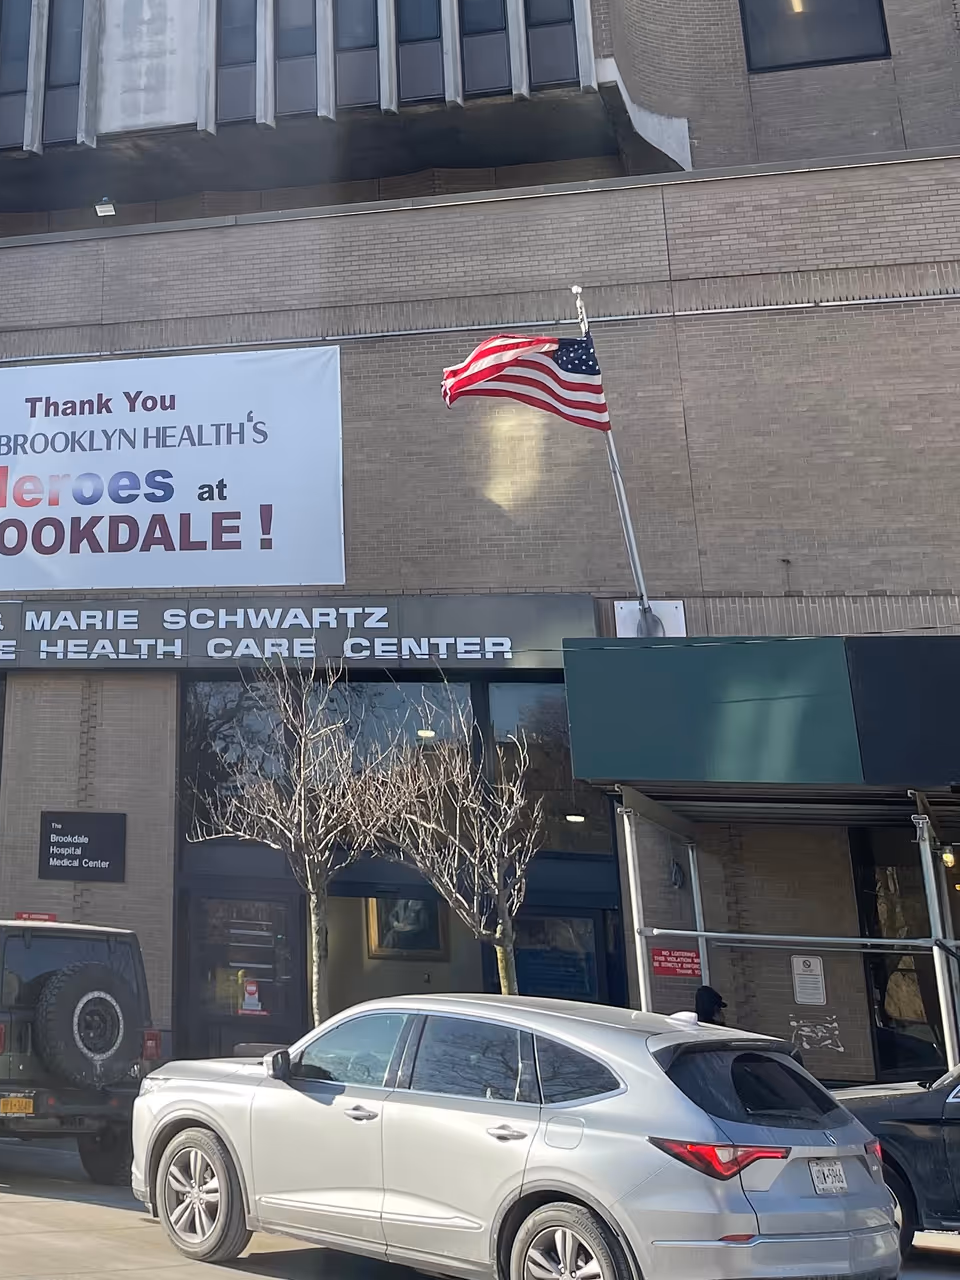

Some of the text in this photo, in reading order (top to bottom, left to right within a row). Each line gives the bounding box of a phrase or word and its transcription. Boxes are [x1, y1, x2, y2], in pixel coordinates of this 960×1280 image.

[24, 390, 176, 418] Thank You
[143, 410, 269, 449] HEALTH'S
[196, 477, 228, 502] at
[24, 608, 139, 631] MARIE
[162, 606, 389, 630] SCHWARTZ
[39, 638, 182, 661] HEALTH
[206, 637, 316, 660] CARE
[343, 636, 513, 660] CENTER
[49, 846, 82, 856] Hospital
[50, 834, 89, 844] Brookdale
[49, 858, 110, 869] Medical Center
